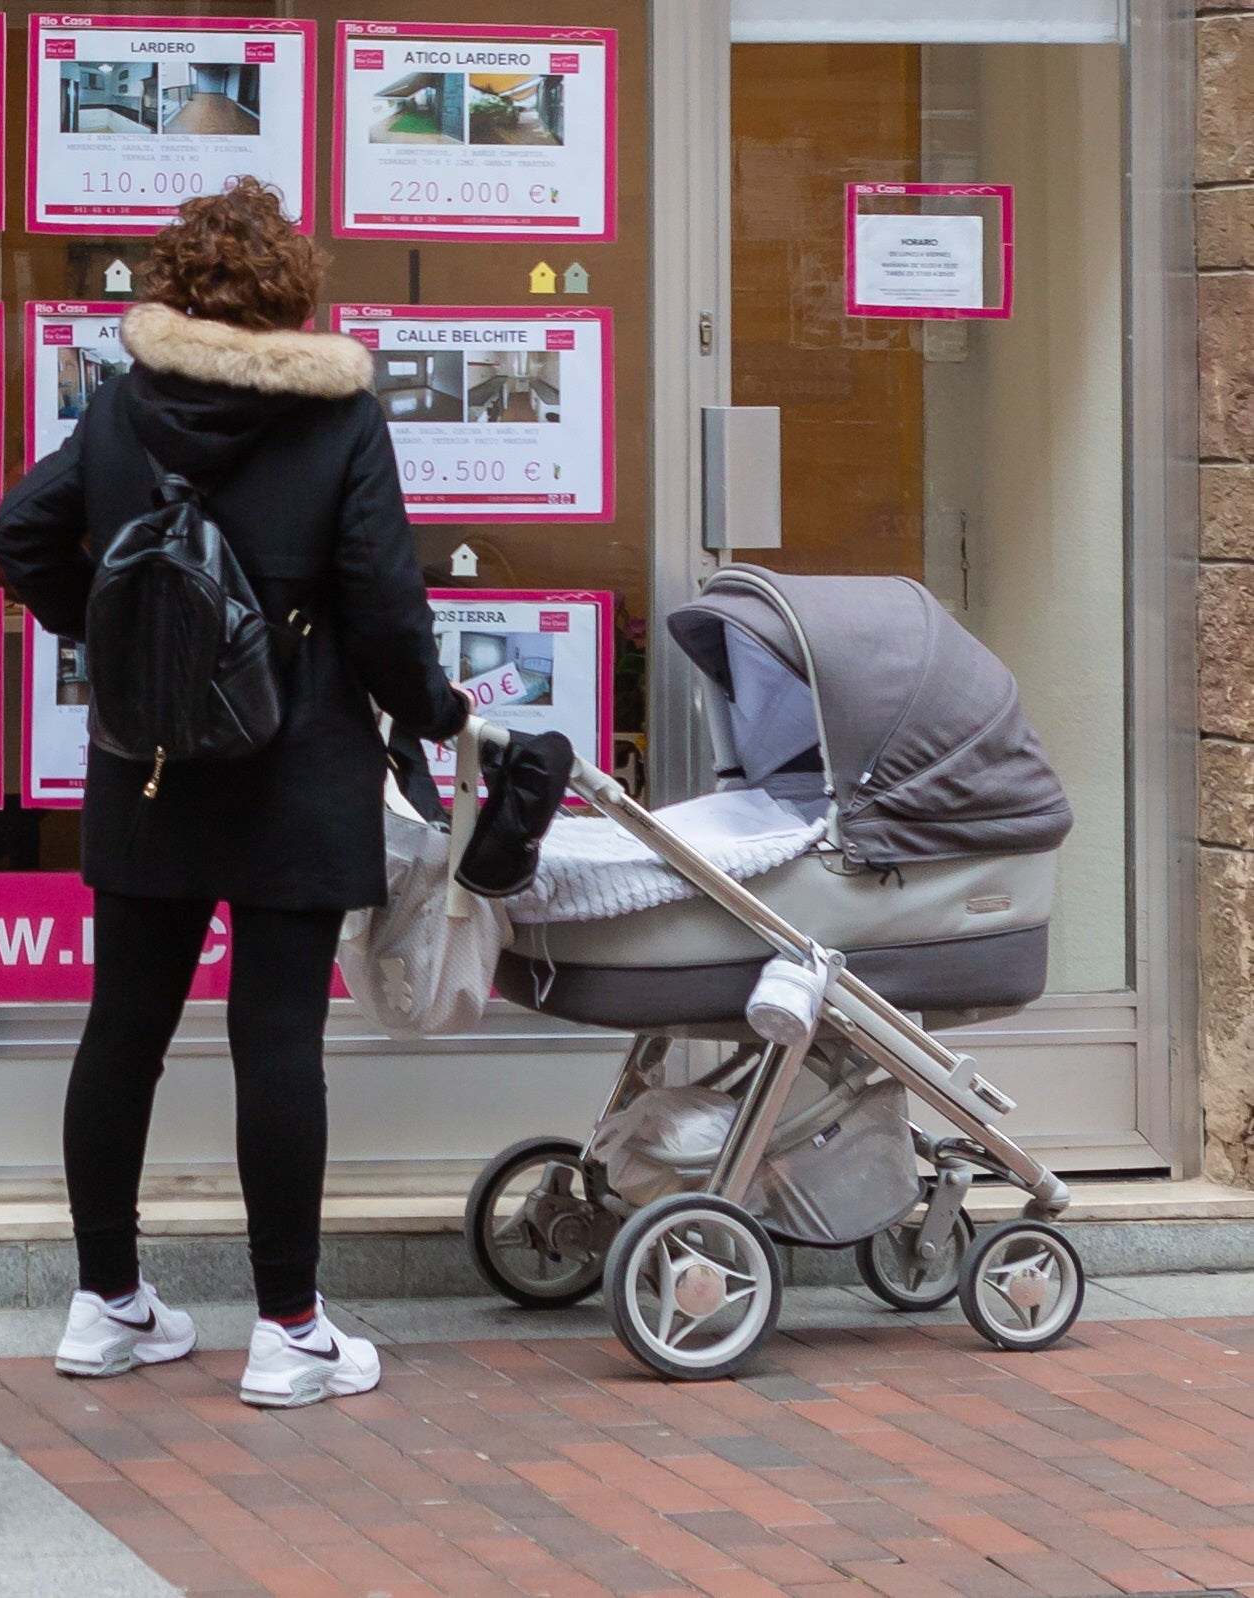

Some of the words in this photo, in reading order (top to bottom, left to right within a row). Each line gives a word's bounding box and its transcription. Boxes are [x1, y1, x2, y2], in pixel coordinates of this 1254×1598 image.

[40, 17, 57, 26] Rio
[62, 17, 92, 27] Casa
[131, 42, 195, 53] LARDERO
[405, 52, 451, 64] ATICO
[456, 53, 530, 65] LARDERO
[83, 172, 203, 194] 110.000
[390, 181, 509, 203] 220.000
[35, 304, 53, 312] Rio
[58, 303, 87, 313] Casa
[397, 330, 446, 342] CALLE
[452, 330, 527, 342] BELCHITE
[525, 462, 540, 481] €
[435, 610, 506, 622] OSIERRA
